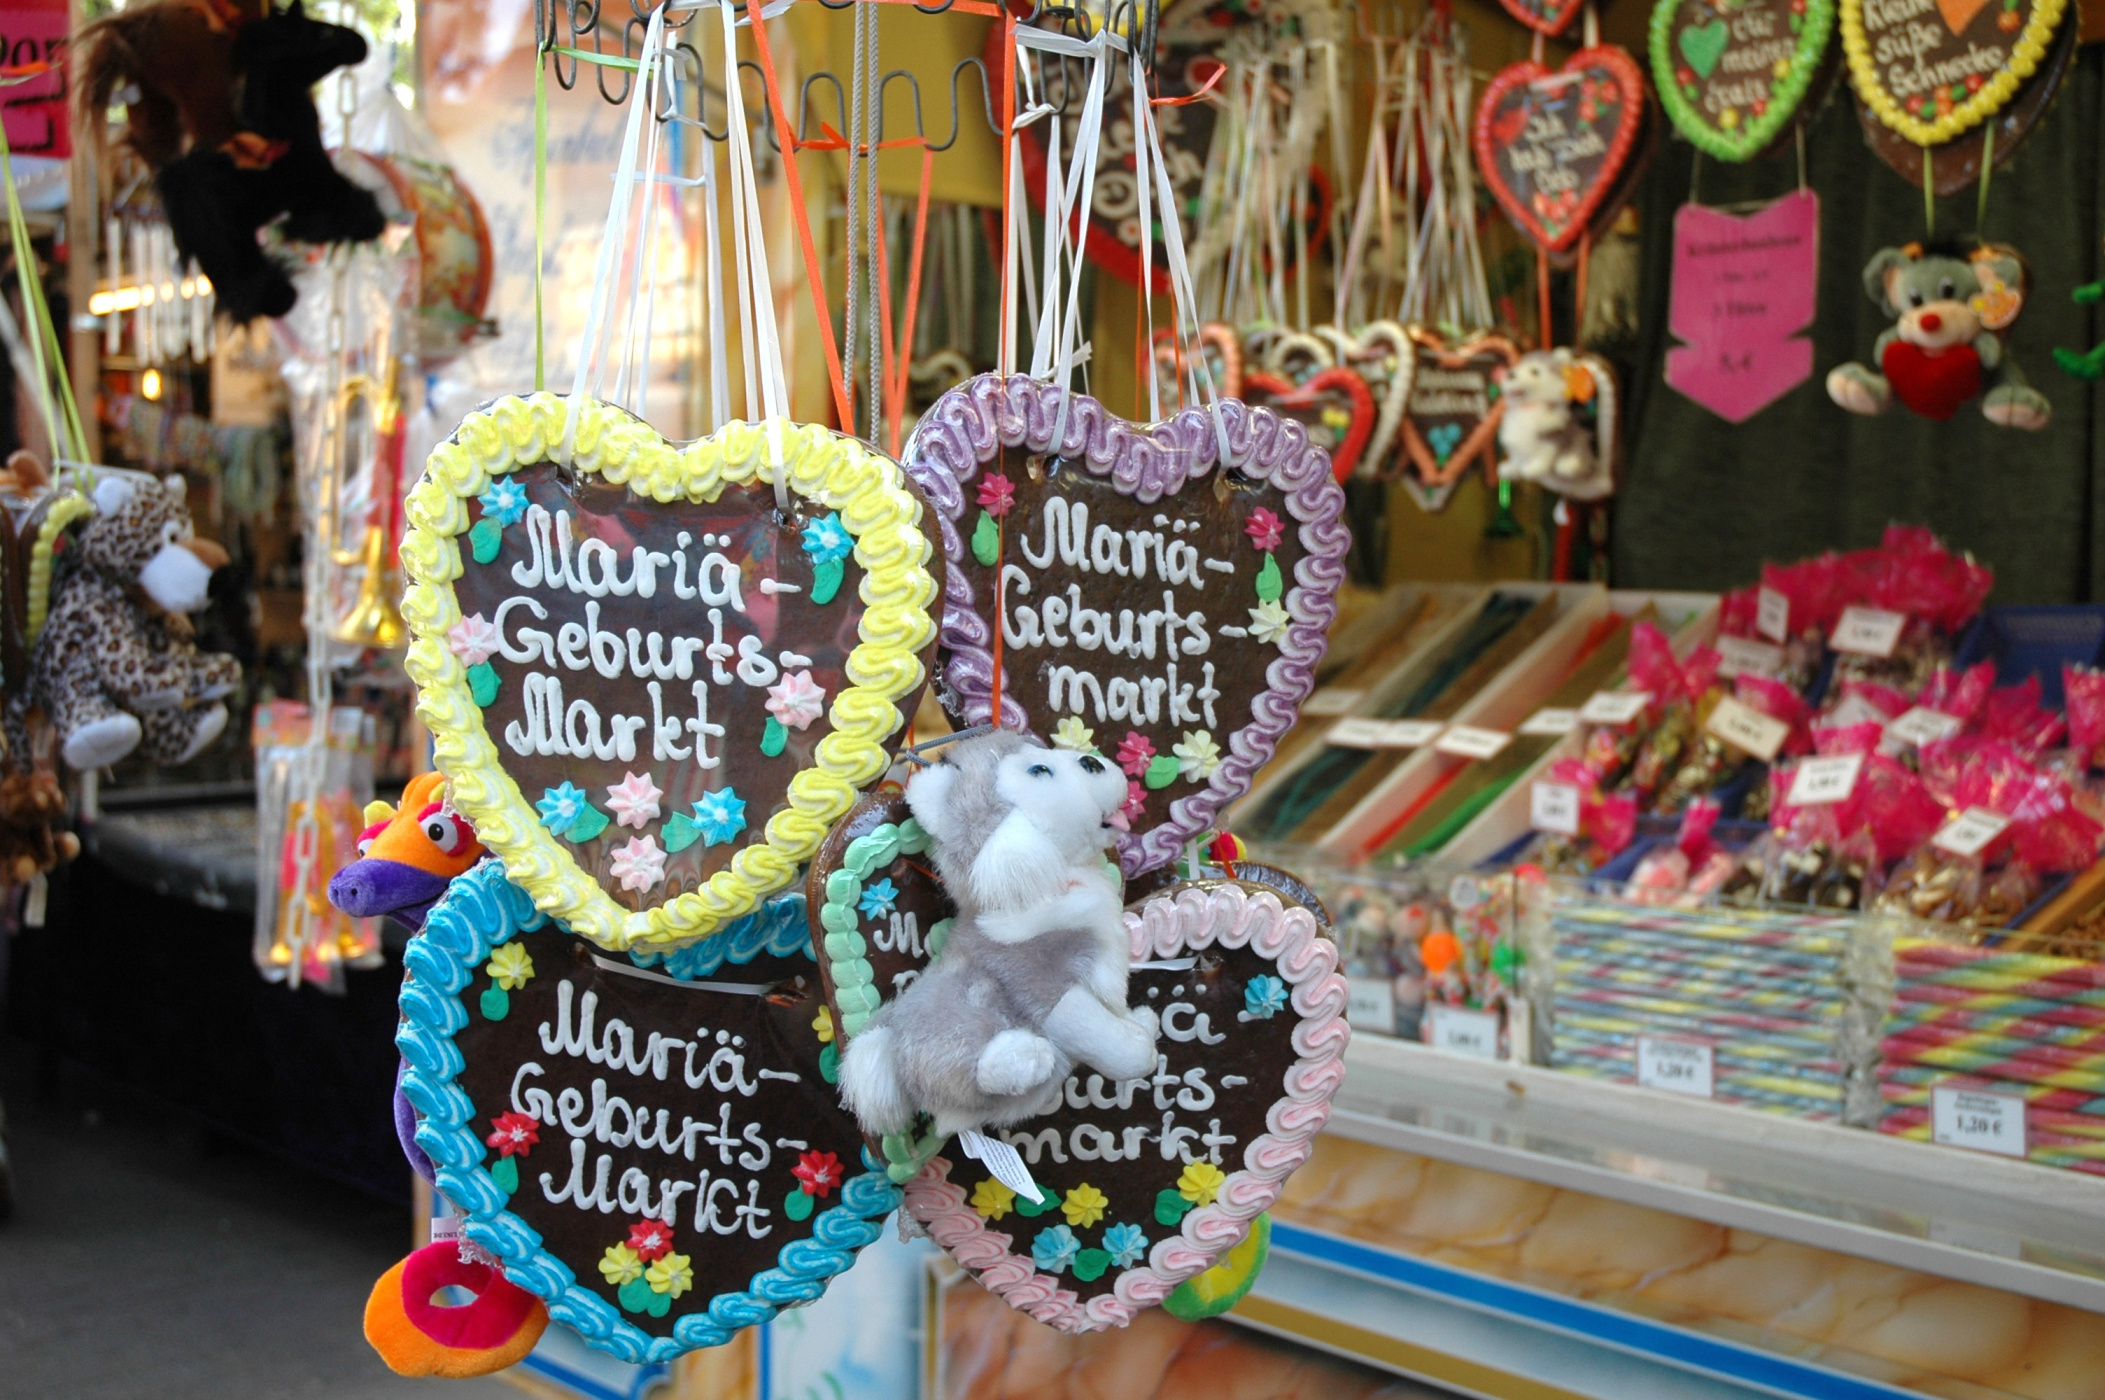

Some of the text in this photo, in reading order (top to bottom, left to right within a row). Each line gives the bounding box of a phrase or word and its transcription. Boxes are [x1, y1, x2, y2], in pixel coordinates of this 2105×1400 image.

[511, 503, 802, 613] Mariä-
[1020, 496, 1235, 591] Mariä-
[493, 595, 813, 687] Geburts-
[995, 564, 1248, 662] Geburts-
[504, 671, 726, 770] Markt
[1047, 661, 1222, 730] markt
[538, 978, 802, 1097] Mariä-
[510, 1061, 809, 1172] Geburts-
[1000, 1110, 1237, 1166] markt
[538, 1138, 773, 1240] Markt
